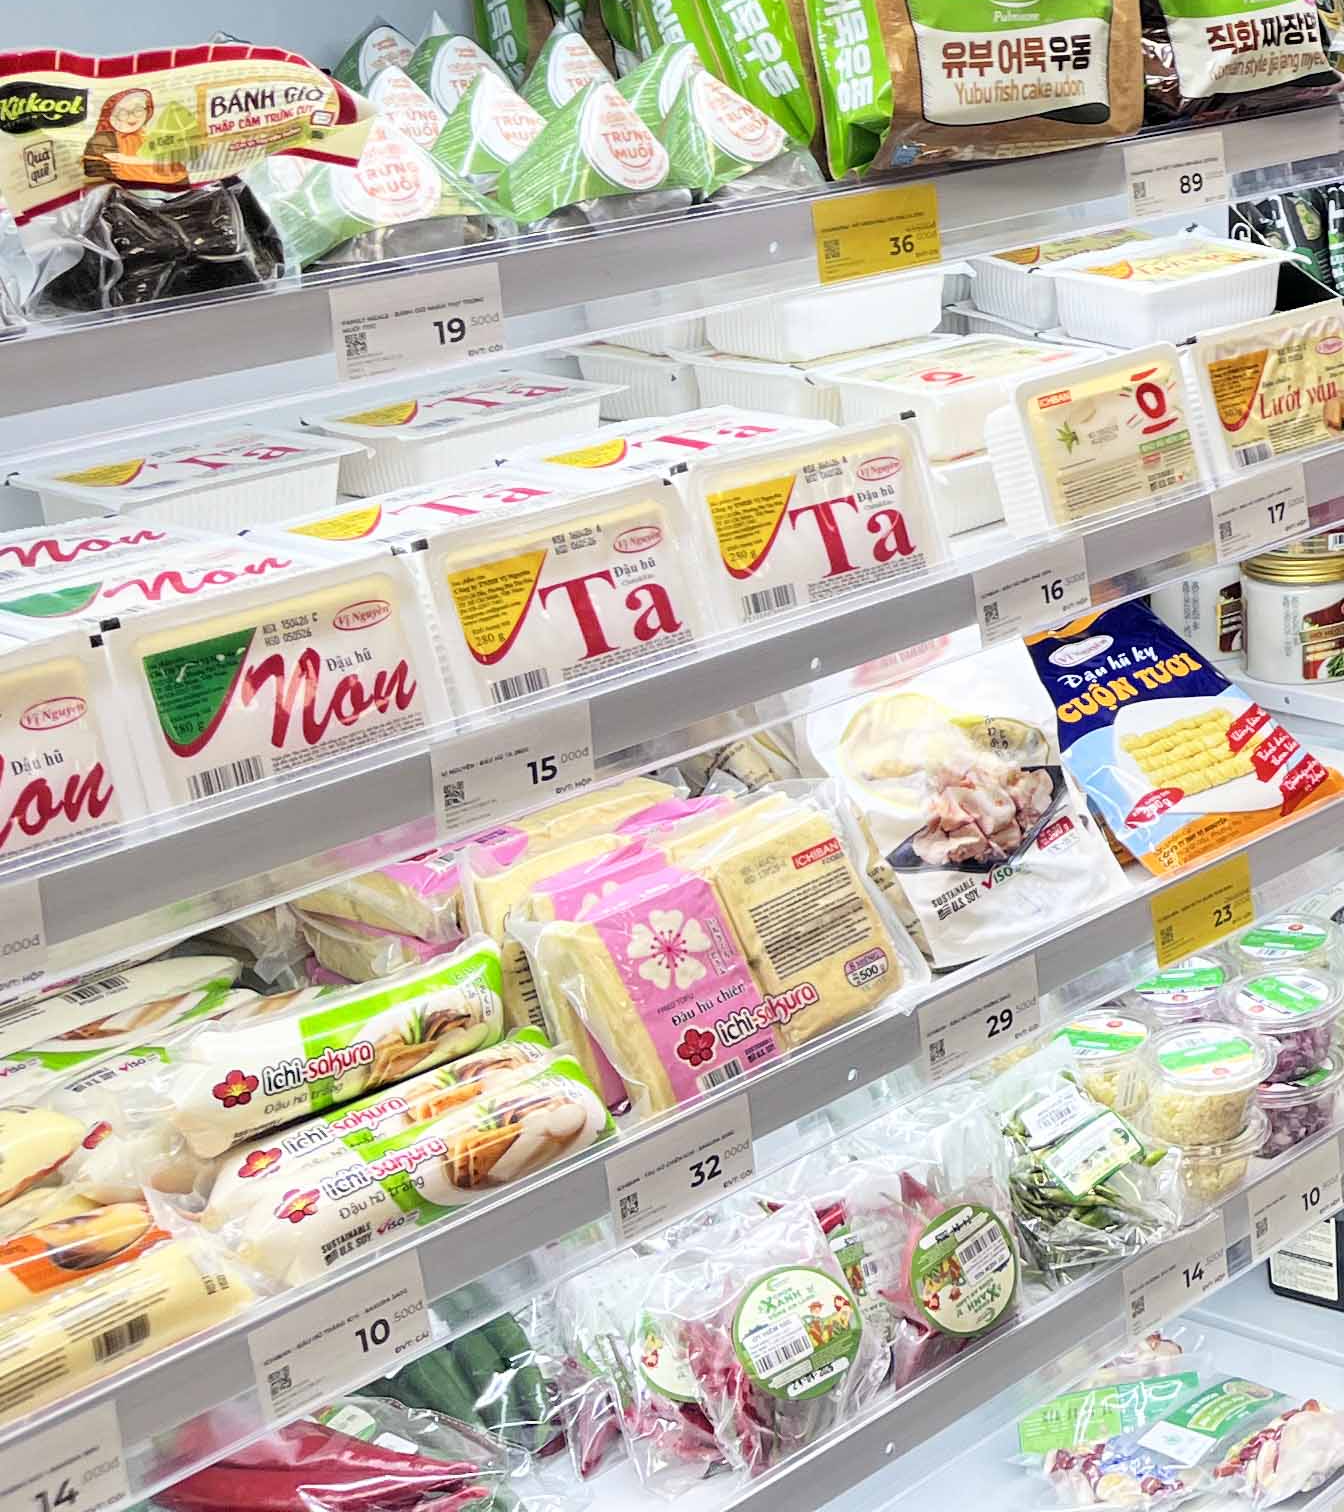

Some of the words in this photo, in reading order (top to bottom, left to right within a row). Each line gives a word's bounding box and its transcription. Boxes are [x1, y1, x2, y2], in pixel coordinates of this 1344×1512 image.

[1206, 19, 1260, 55] 직화
[942, 40, 993, 79] 유부
[999, 37, 1047, 75] 어묵
[1050, 34, 1092, 72] 우동
[210, 86, 276, 119] BÁNH
[284, 85, 325, 104] GIÒ
[955, 79, 993, 105] Yubu
[994, 78, 1020, 103] fish
[1022, 77, 1053, 100] cake
[1055, 75, 1086, 98] udon
[1179, 174, 1205, 195] 89
[889, 235, 914, 256] 36
[433, 317, 466, 345] 19
[1259, 384, 1301, 420] Lướt
[1307, 376, 1337, 404] ván
[632, 420, 778, 451] Ta
[386, 486, 552, 520] Ta
[856, 490, 879, 503] Đậu
[1267, 501, 1286, 525] 17
[788, 494, 917, 579] Ta
[103, 556, 293, 602] Non
[613, 562, 639, 580] Đậu
[641, 556, 656, 570] hũ
[1041, 579, 1064, 604] 16
[538, 570, 684, 662] Ta
[326, 655, 353, 673] Đậu
[354, 648, 373, 663] hũ
[1057, 666, 1108, 688] Đậu
[1108, 653, 1131, 671] hũ
[1132, 645, 1159, 665] ky
[242, 648, 417, 749] Non
[1057, 675, 1139, 723] CUỘN
[1133, 652, 1203, 690] TƯƠI
[11, 754, 42, 777] Đậu
[43, 748, 64, 768] hũ
[527, 755, 558, 785] 15
[0, 755, 115, 847] on
[794, 840, 841, 867] ICHIBAN
[931, 878, 976, 908] SUSTAINABLE
[1213, 903, 1234, 928] 23
[859, 965, 879, 981] 500
[716, 980, 746, 1006] chiên
[717, 984, 819, 1044] ichi-sakura
[986, 1008, 1014, 1039] 29
[263, 1040, 375, 1097] ichi-sakura
[285, 1097, 408, 1153] ichi-sakura
[324, 1138, 448, 1198] ichi-sakura
[690, 1154, 722, 1188] 32
[339, 1194, 368, 1221] Đậu
[369, 1186, 389, 1209] hũ
[391, 1174, 427, 1203] trắng
[1300, 1189, 1321, 1212] 10
[321, 1221, 373, 1257] SUSTAINABLE
[1182, 1262, 1204, 1289] 14
[354, 1317, 391, 1353] 10
[36, 1478, 80, 1512] 14
